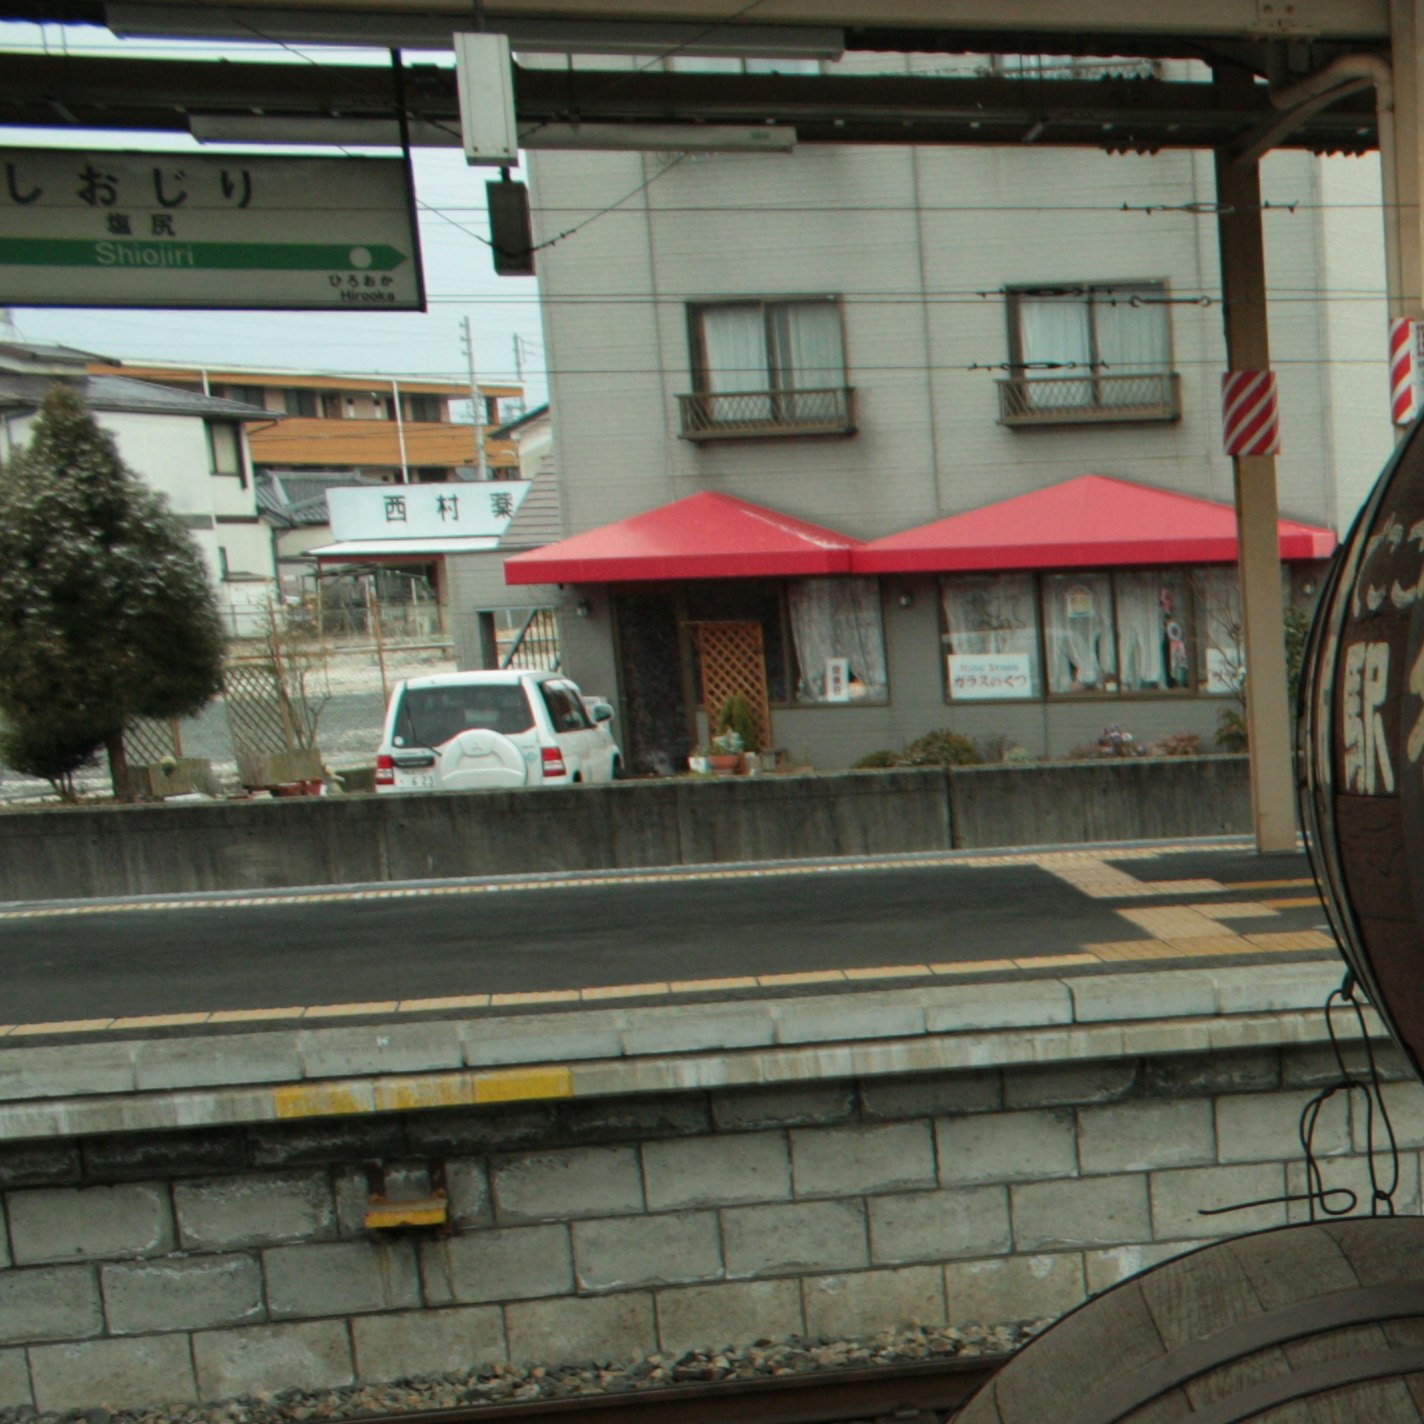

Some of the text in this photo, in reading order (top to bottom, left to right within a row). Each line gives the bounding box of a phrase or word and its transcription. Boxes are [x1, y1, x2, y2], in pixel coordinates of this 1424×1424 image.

[6, 163, 253, 209] しおじり
[106, 213, 176, 237] 塩尻
[94, 242, 195, 269] Shiojiri
[329, 273, 394, 289] ひろおか
[340, 289, 395, 303] Hirooka
